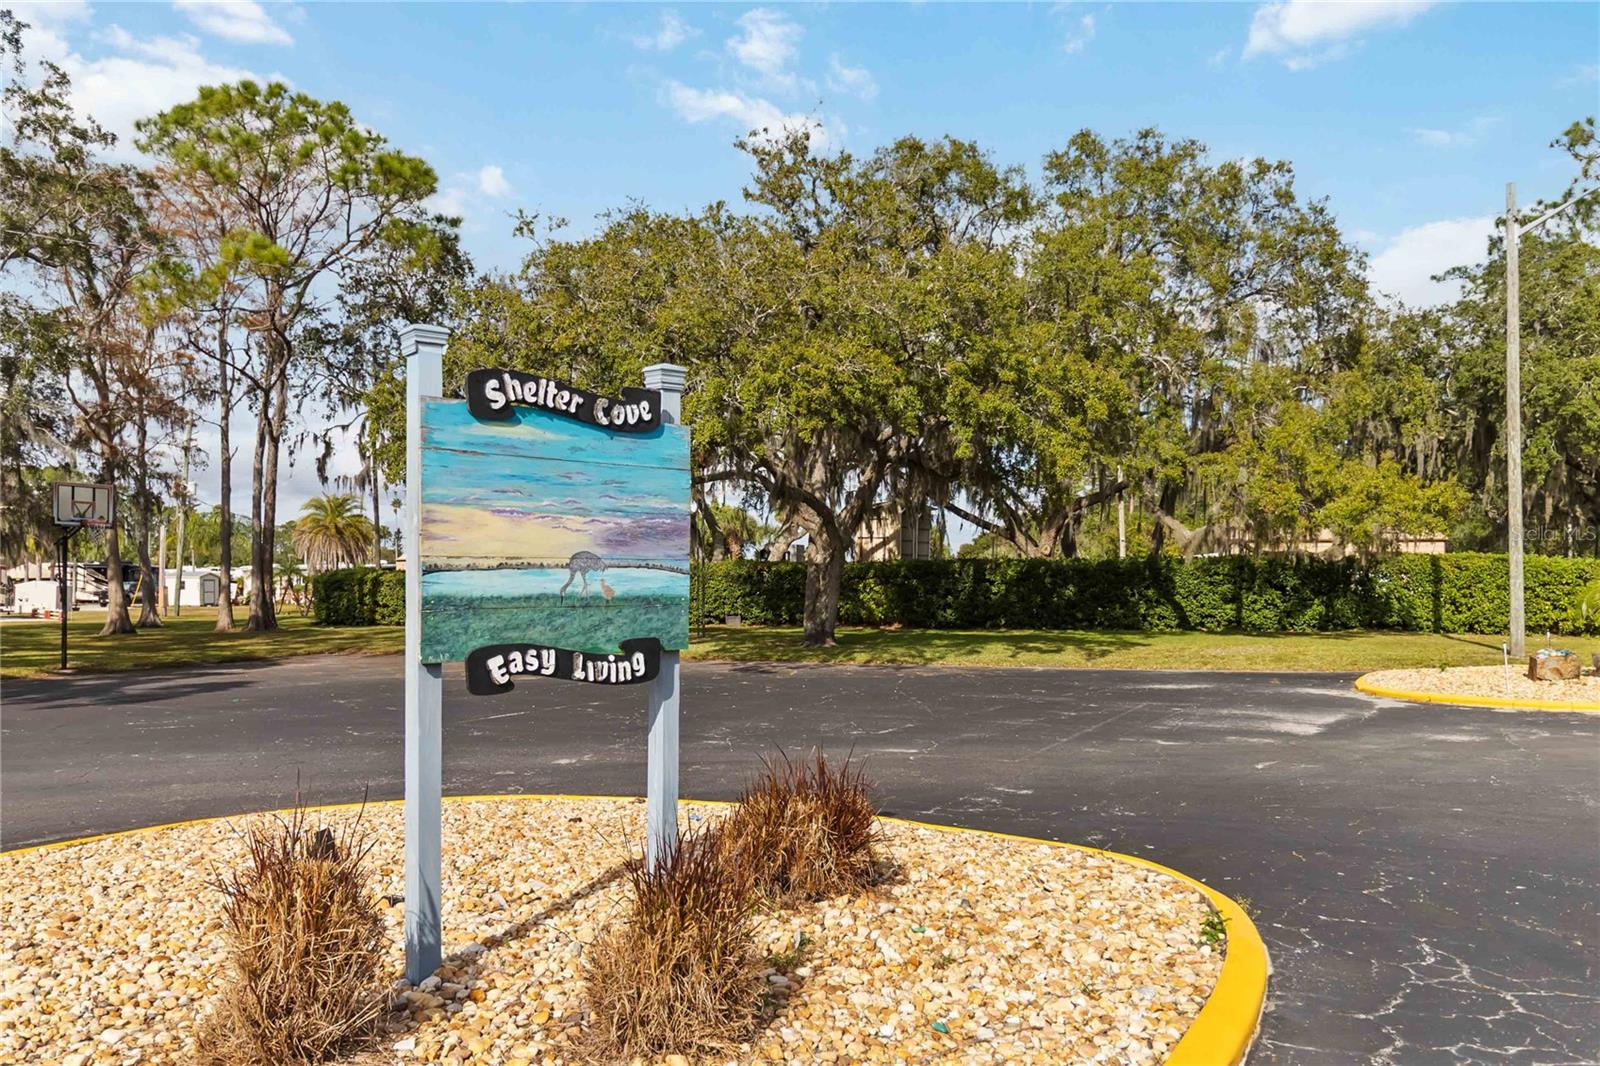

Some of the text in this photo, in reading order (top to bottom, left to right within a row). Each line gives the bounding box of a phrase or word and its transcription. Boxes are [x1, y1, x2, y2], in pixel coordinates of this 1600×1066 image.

[485, 373, 652, 425] Shelter Cove
[487, 649, 646, 685] Easy Living
